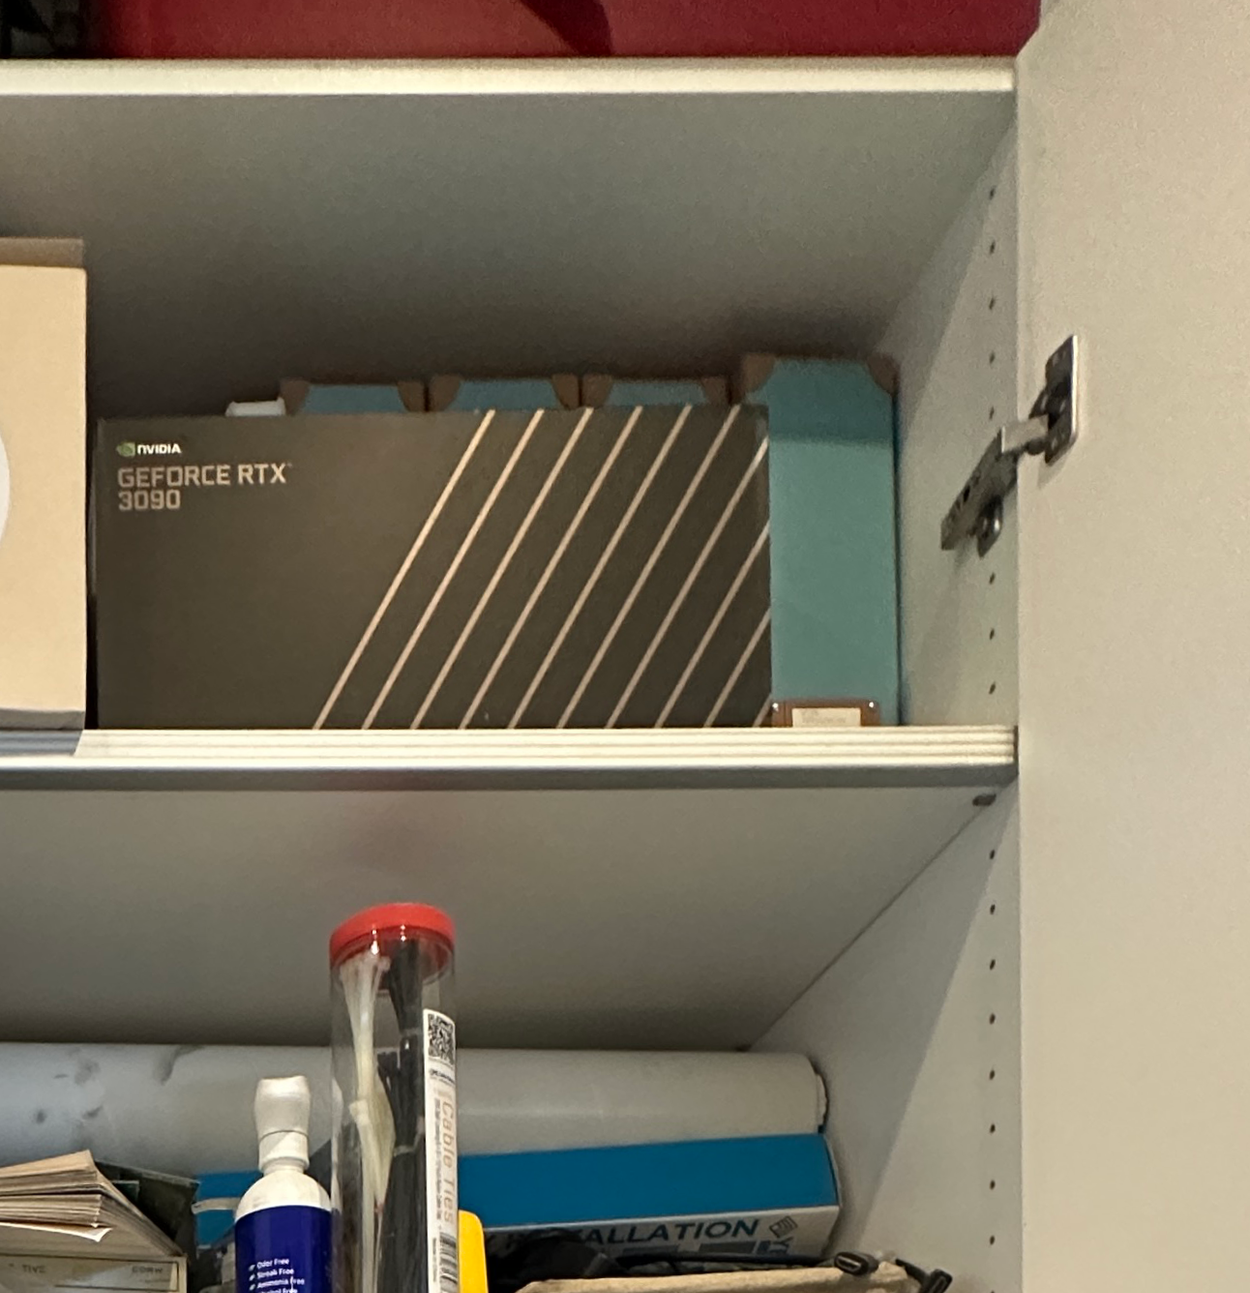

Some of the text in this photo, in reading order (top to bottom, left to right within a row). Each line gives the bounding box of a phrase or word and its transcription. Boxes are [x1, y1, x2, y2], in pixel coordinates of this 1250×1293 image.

[117, 462, 287, 488] GEFORCE RTX
[118, 489, 182, 511] 3090
